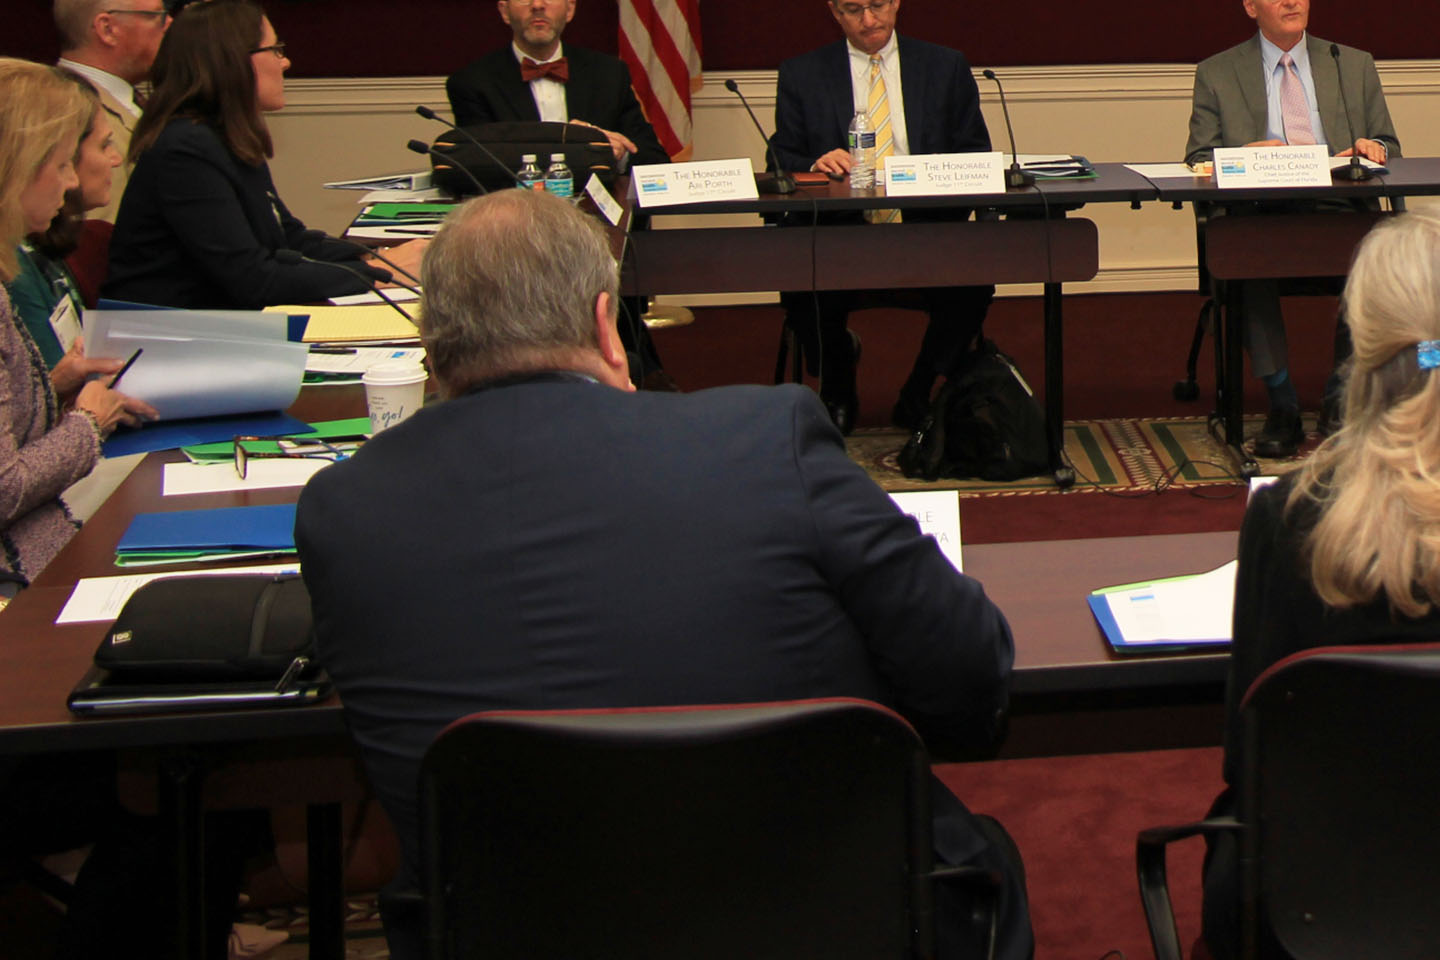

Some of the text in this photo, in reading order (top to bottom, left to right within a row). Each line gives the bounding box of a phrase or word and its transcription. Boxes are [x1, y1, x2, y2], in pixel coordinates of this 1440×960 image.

[923, 161, 992, 171] THE HONORABLE
[1253, 162, 1286, 171] CHARLES
[1287, 161, 1320, 170] CANADY
[928, 172, 952, 182] STEVE
[954, 172, 990, 181] LEIFMAN
[704, 179, 733, 189] PORTH
